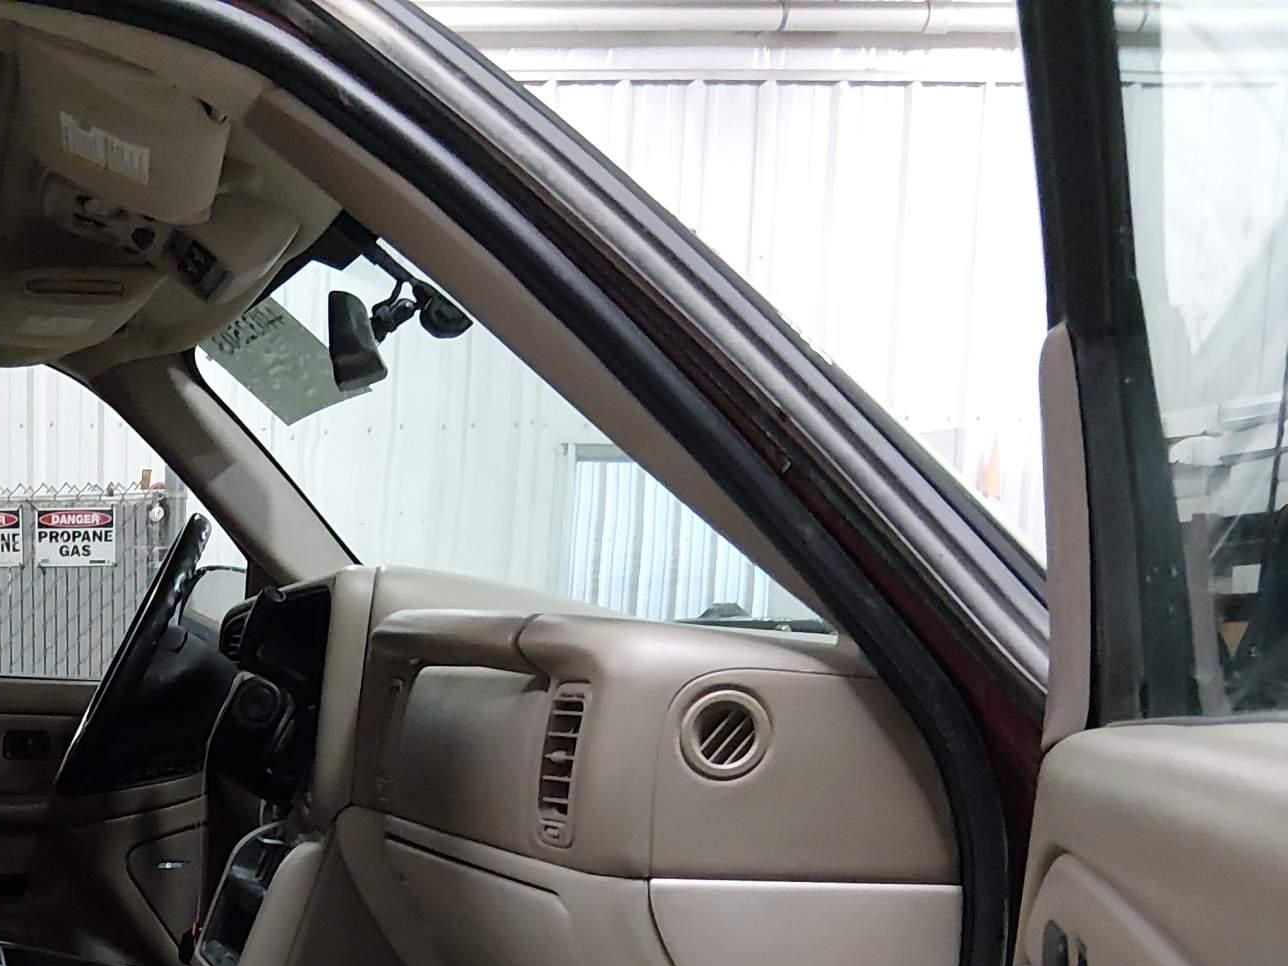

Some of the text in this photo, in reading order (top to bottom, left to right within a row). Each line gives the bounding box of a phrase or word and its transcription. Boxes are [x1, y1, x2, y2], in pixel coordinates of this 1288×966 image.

[51, 514, 100, 525] DANGER
[38, 530, 113, 543] PROPANE
[59, 544, 91, 557] GAS
